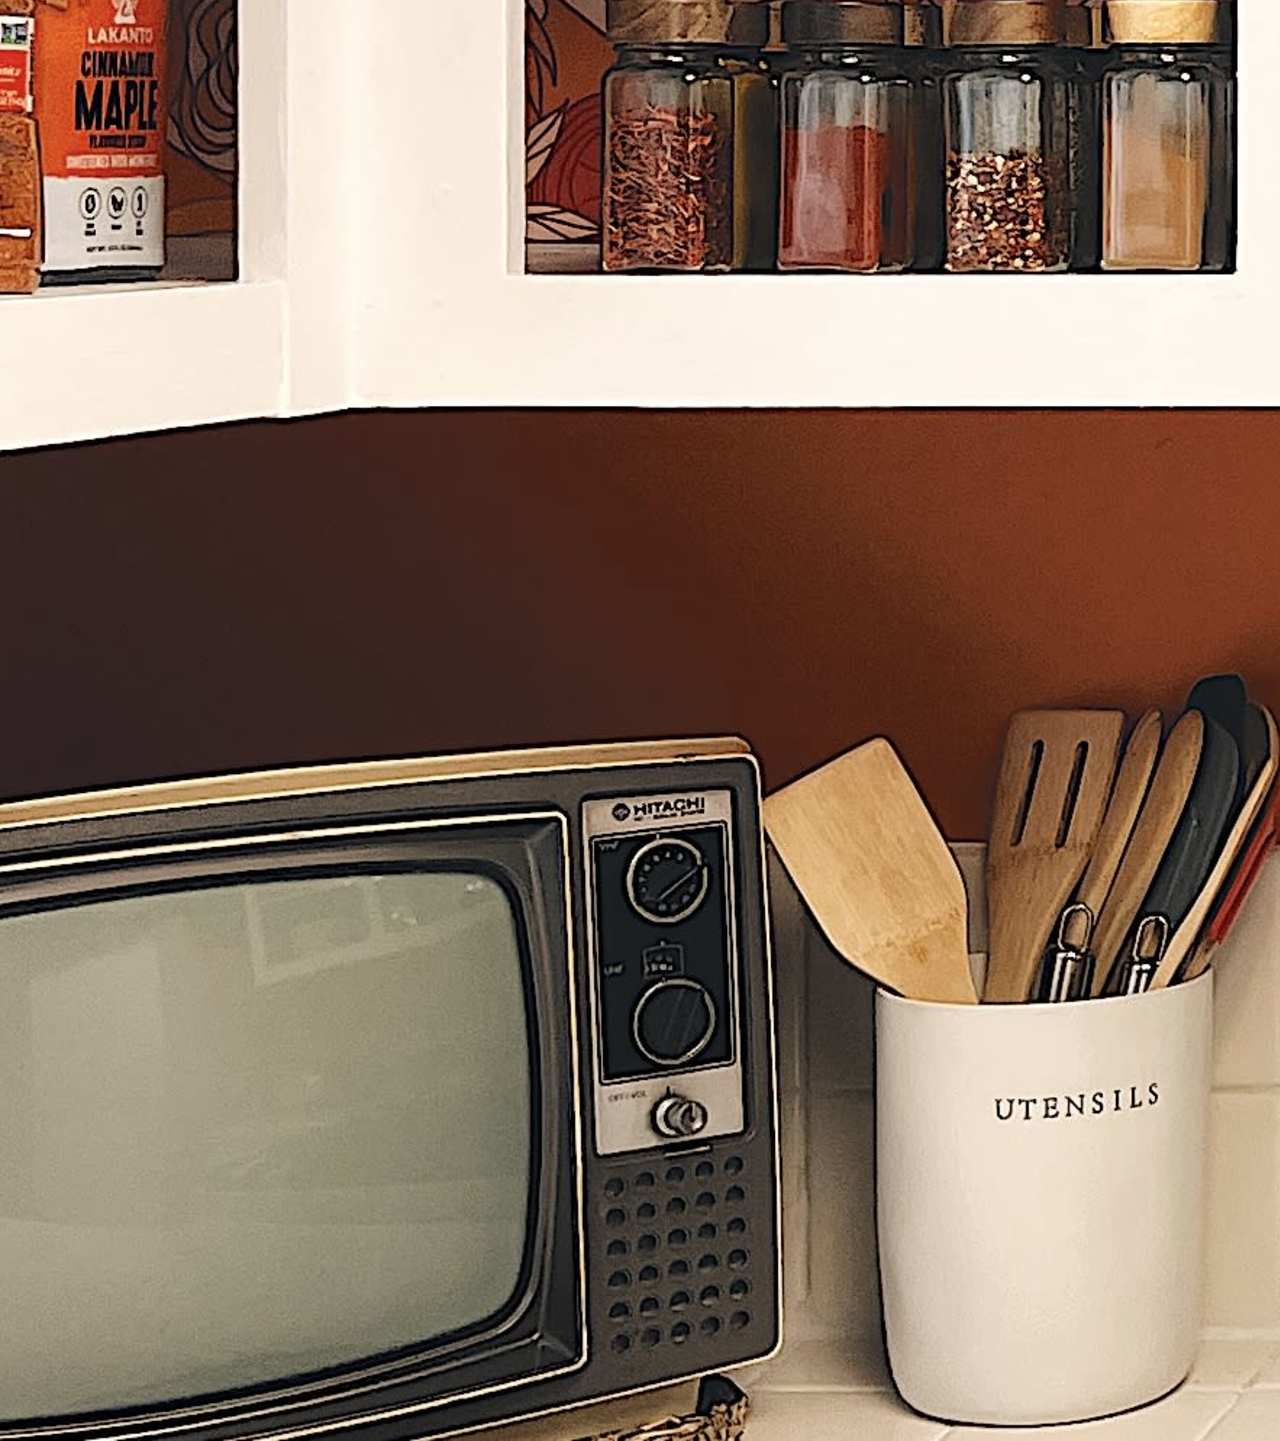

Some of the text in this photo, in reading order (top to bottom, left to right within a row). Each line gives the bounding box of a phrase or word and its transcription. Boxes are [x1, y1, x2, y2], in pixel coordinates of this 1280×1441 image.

[87, 27, 154, 45] LAKANTO
[74, 79, 159, 131] MAPLE
[633, 797, 706, 816] HITACHI
[993, 1082, 1159, 1121] UTENSILS
